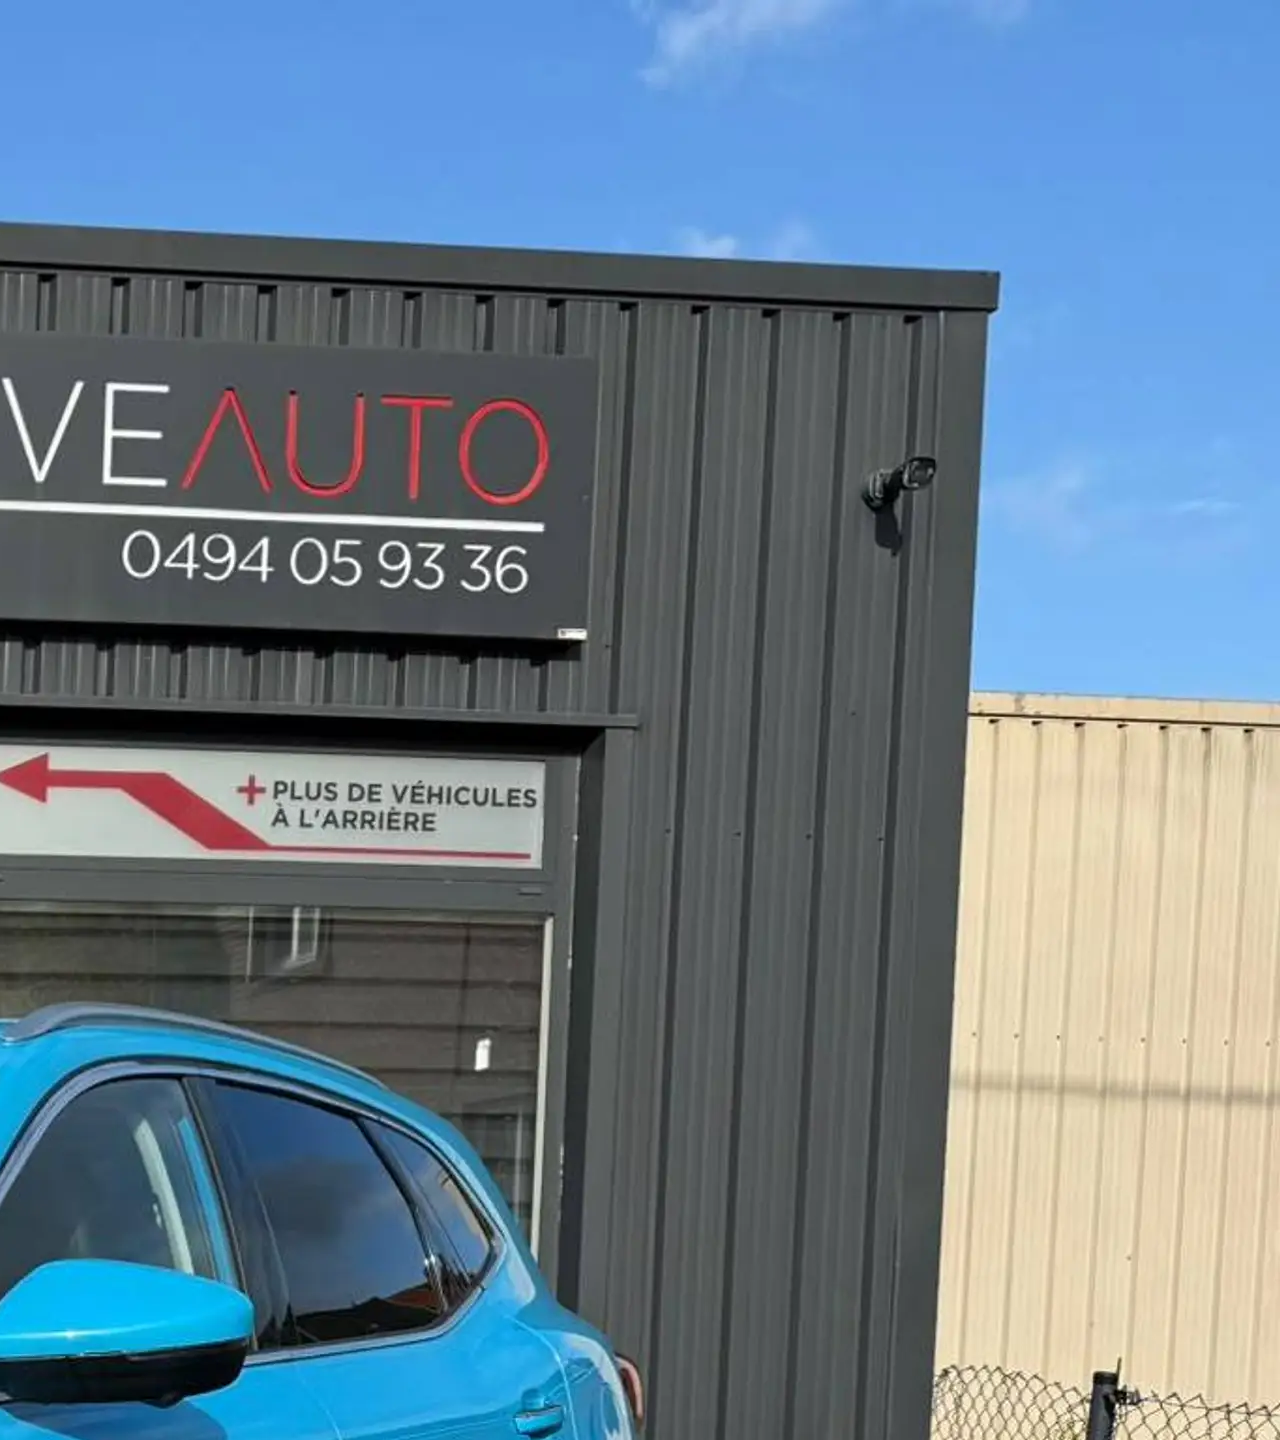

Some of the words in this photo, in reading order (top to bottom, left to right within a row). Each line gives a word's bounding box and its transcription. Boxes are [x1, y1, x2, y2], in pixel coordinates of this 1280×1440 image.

[122, 531, 273, 582] 0494
[289, 537, 363, 588] 05
[378, 541, 444, 591] 93
[460, 544, 529, 593] 36
[272, 780, 339, 804] PLUS
[348, 782, 383, 804] DE
[391, 780, 538, 808] VÉHICULES
[271, 804, 290, 828] À
[299, 806, 437, 832] L'ARRIÈRE
